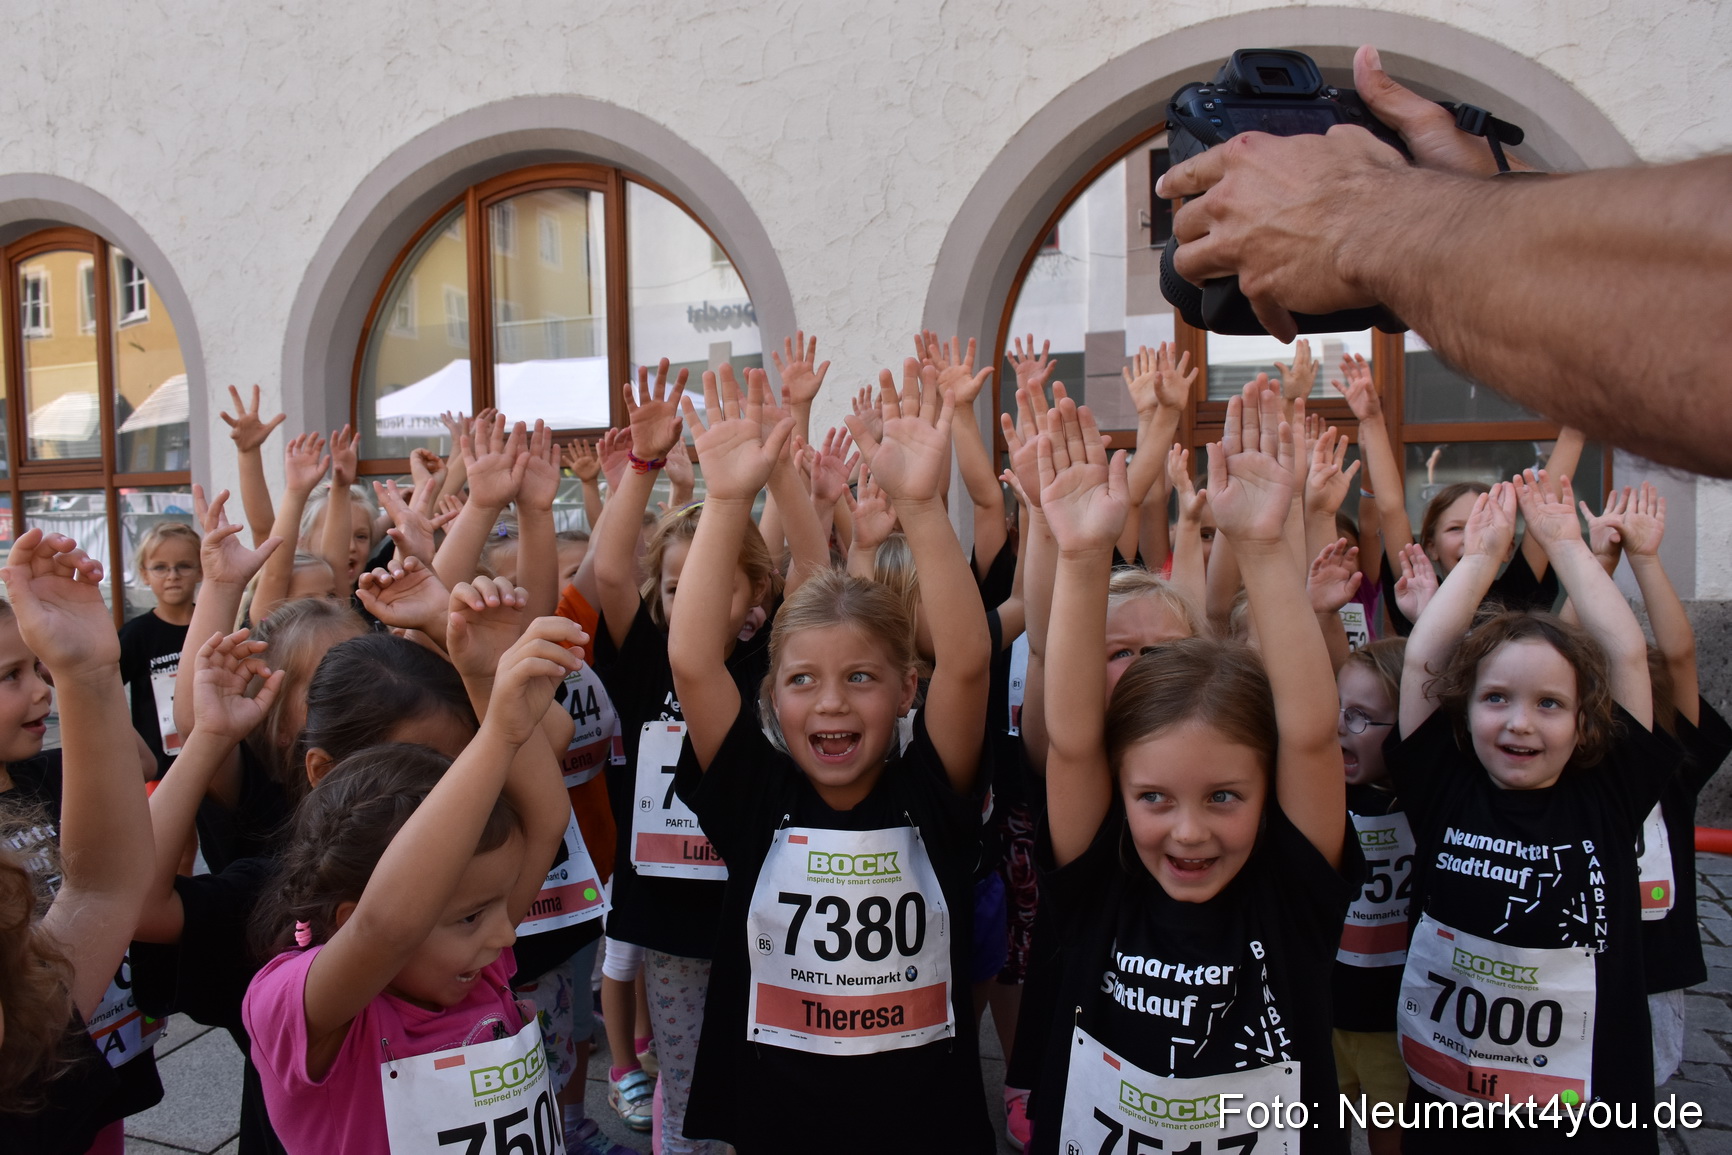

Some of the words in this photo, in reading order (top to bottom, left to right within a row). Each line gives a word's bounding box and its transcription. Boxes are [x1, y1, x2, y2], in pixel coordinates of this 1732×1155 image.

[570, 685, 601, 726] 44
[562, 752, 592, 772] Lena
[641, 800, 651, 809] B1
[665, 818, 695, 828] PARTL
[683, 840, 722, 861] Luis
[1443, 827, 1549, 861] Neumarkter
[808, 851, 901, 876] BOCK
[1436, 852, 1534, 890] Stadtlauf
[807, 875, 834, 884] inspired
[836, 877, 845, 886] by
[872, 875, 902, 884] concepts
[1582, 840, 1608, 953] BAMBINI
[778, 891, 926, 962] 7380
[1352, 909, 1400, 921] Neumarkt
[759, 939, 771, 951] B5
[791, 968, 832, 985] PARTL
[836, 971, 901, 986] Neumarkt
[1452, 947, 1539, 985] BOCK
[1486, 978, 1506, 987] smart
[1507, 983, 1539, 992] concepts
[802, 999, 904, 1031] Theresa
[1406, 1001, 1417, 1013] B1
[1428, 971, 1563, 1048] 7000
[1432, 1032, 1467, 1055] PARTL
[1468, 1050, 1529, 1065] Neumarkt
[474, 1090, 511, 1108] inspired
[512, 1088, 522, 1097] by
[523, 1077, 538, 1092] smart
[1467, 1071, 1498, 1097] Lif
[1119, 1079, 1221, 1121] BOCK
[1118, 1103, 1147, 1122] inspired
[1148, 1117, 1159, 1127] by
[1161, 1121, 1187, 1130] smart
[1189, 1120, 1220, 1130] concep
